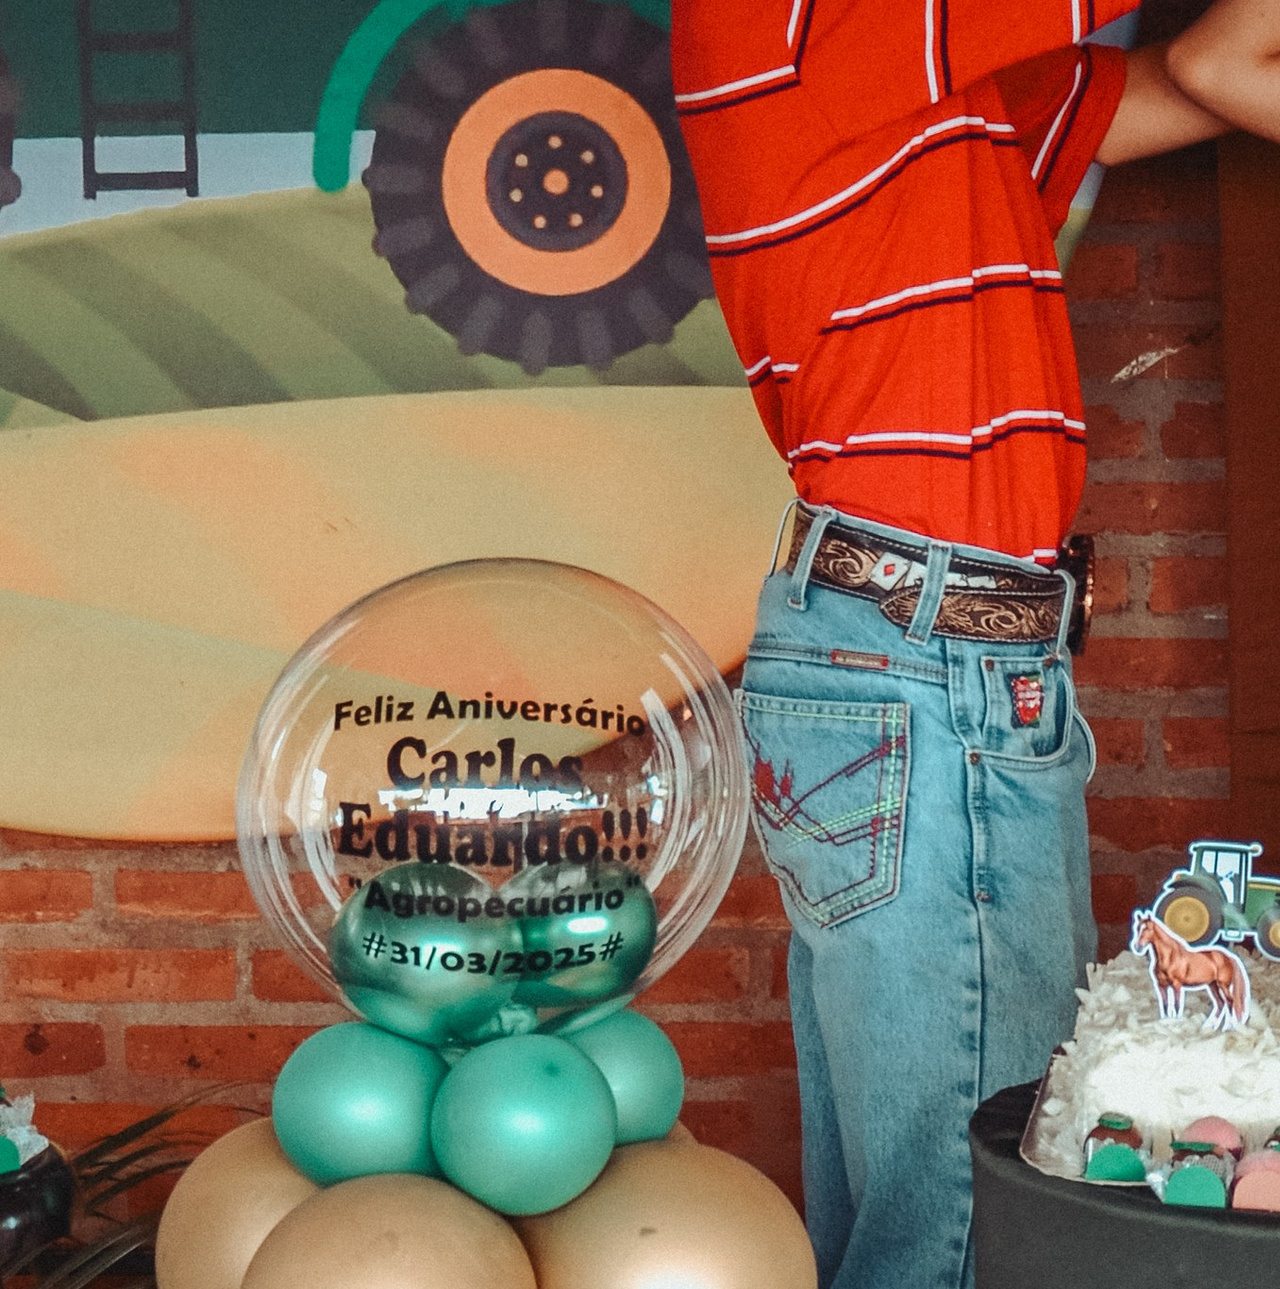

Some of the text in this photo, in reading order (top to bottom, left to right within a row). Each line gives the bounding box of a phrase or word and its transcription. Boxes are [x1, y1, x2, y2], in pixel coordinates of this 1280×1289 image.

[334, 691, 647, 737] Feliz Aniversário
[387, 736, 585, 793] Carlos
[338, 801, 648, 867] Eduardo!!!
[362, 931, 624, 976] #31/03/2025#
